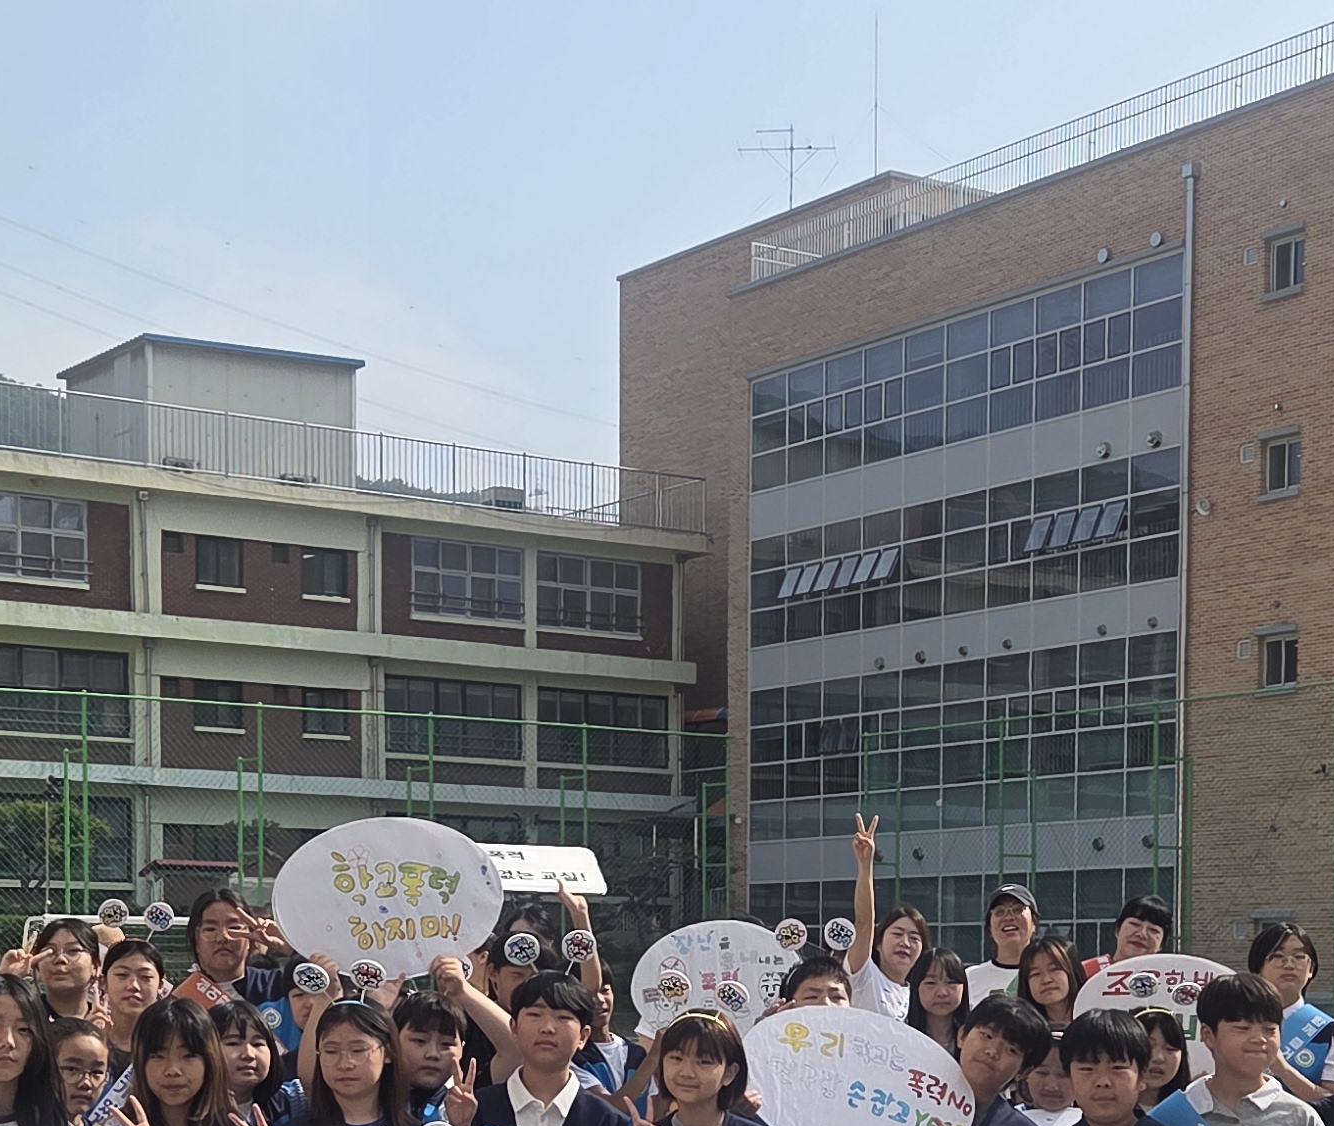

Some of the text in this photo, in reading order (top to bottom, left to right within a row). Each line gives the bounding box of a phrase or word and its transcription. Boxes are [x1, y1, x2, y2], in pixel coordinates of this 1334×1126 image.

[330, 851, 461, 907] 학교폭력
[779, 1022, 845, 1058] 우리
[847, 1081, 911, 1124] 손잡고
